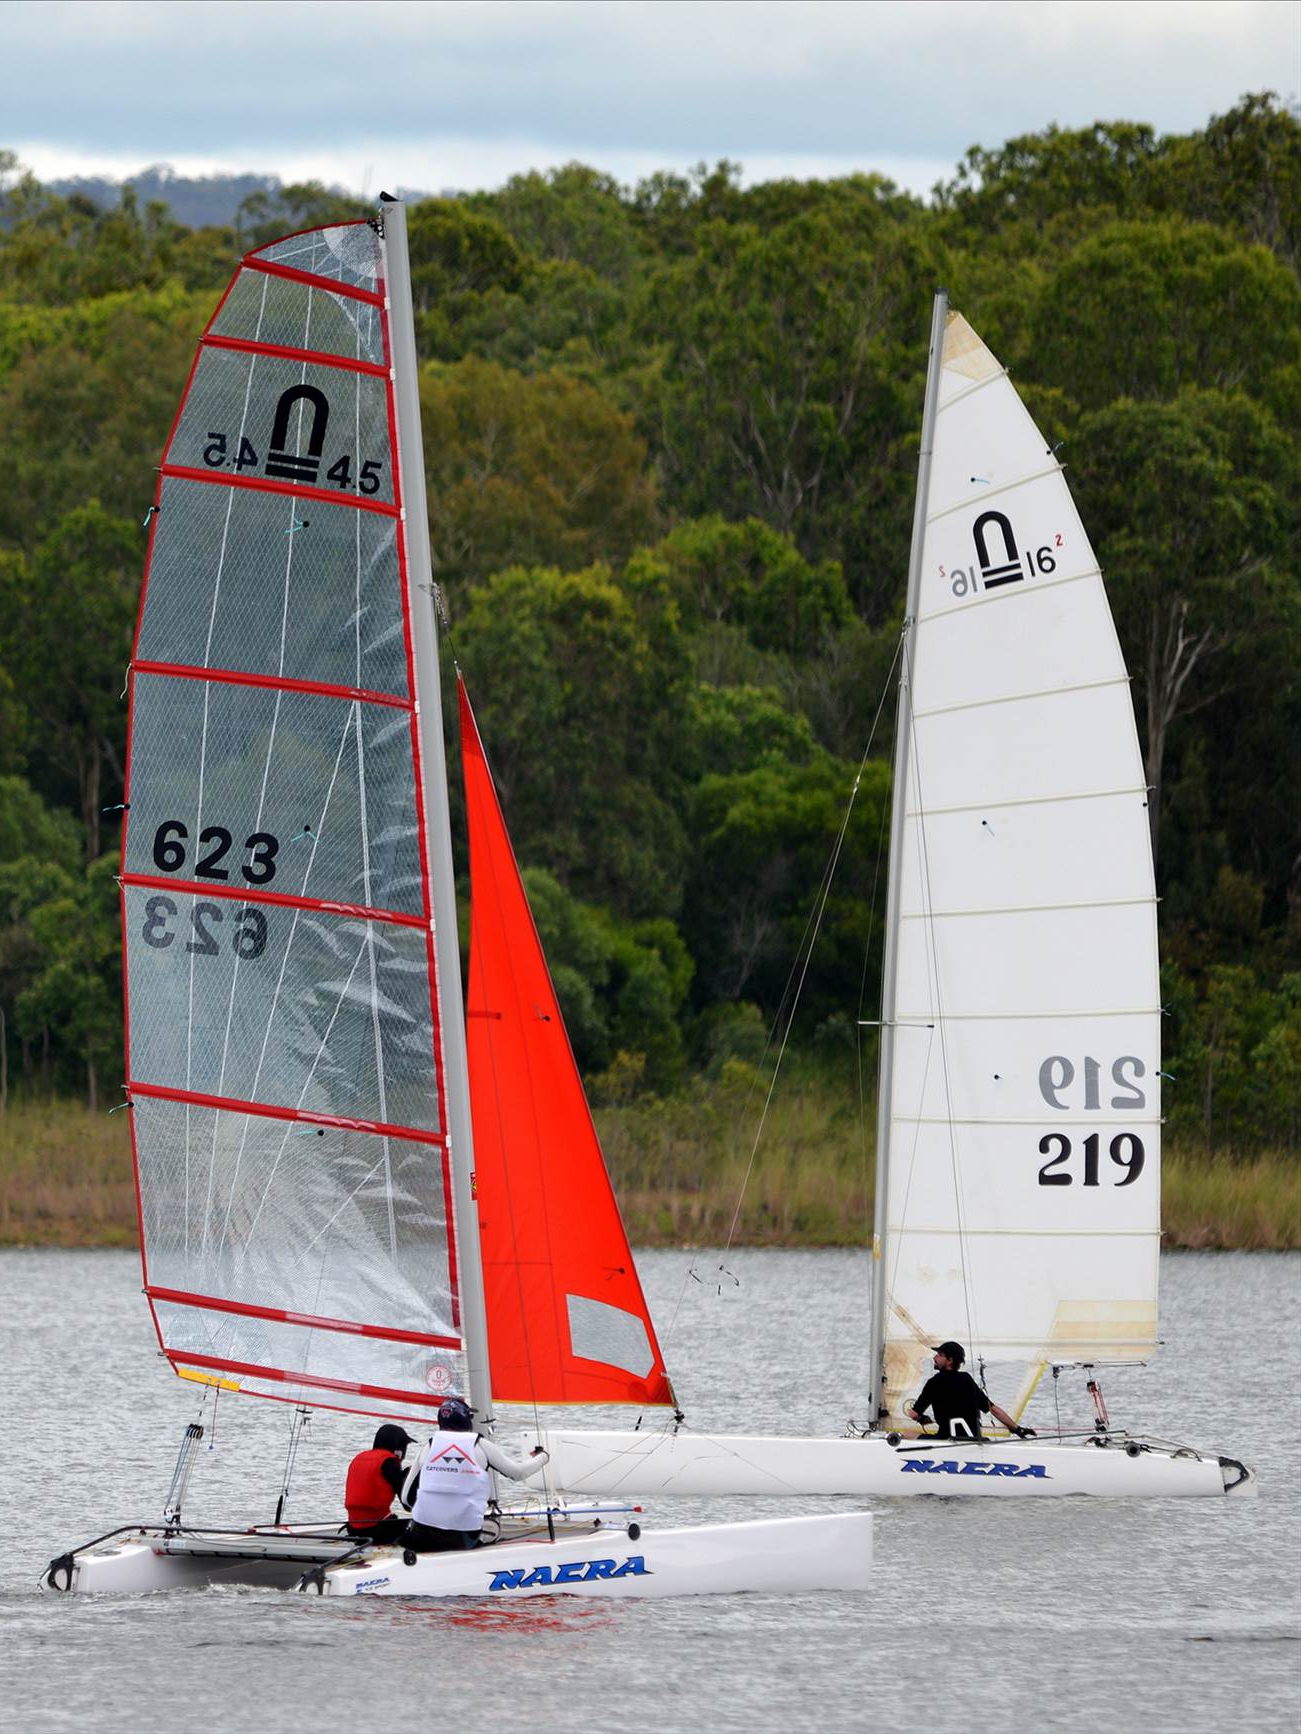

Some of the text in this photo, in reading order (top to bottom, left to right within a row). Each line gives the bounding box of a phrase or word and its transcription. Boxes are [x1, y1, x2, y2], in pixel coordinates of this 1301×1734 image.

[326, 455, 382, 494] 4.5
[152, 820, 280, 885] 623
[1038, 1132, 1146, 1187] 219
[900, 1459, 1053, 1479] NACRA
[486, 1555, 655, 1591] NACRA
